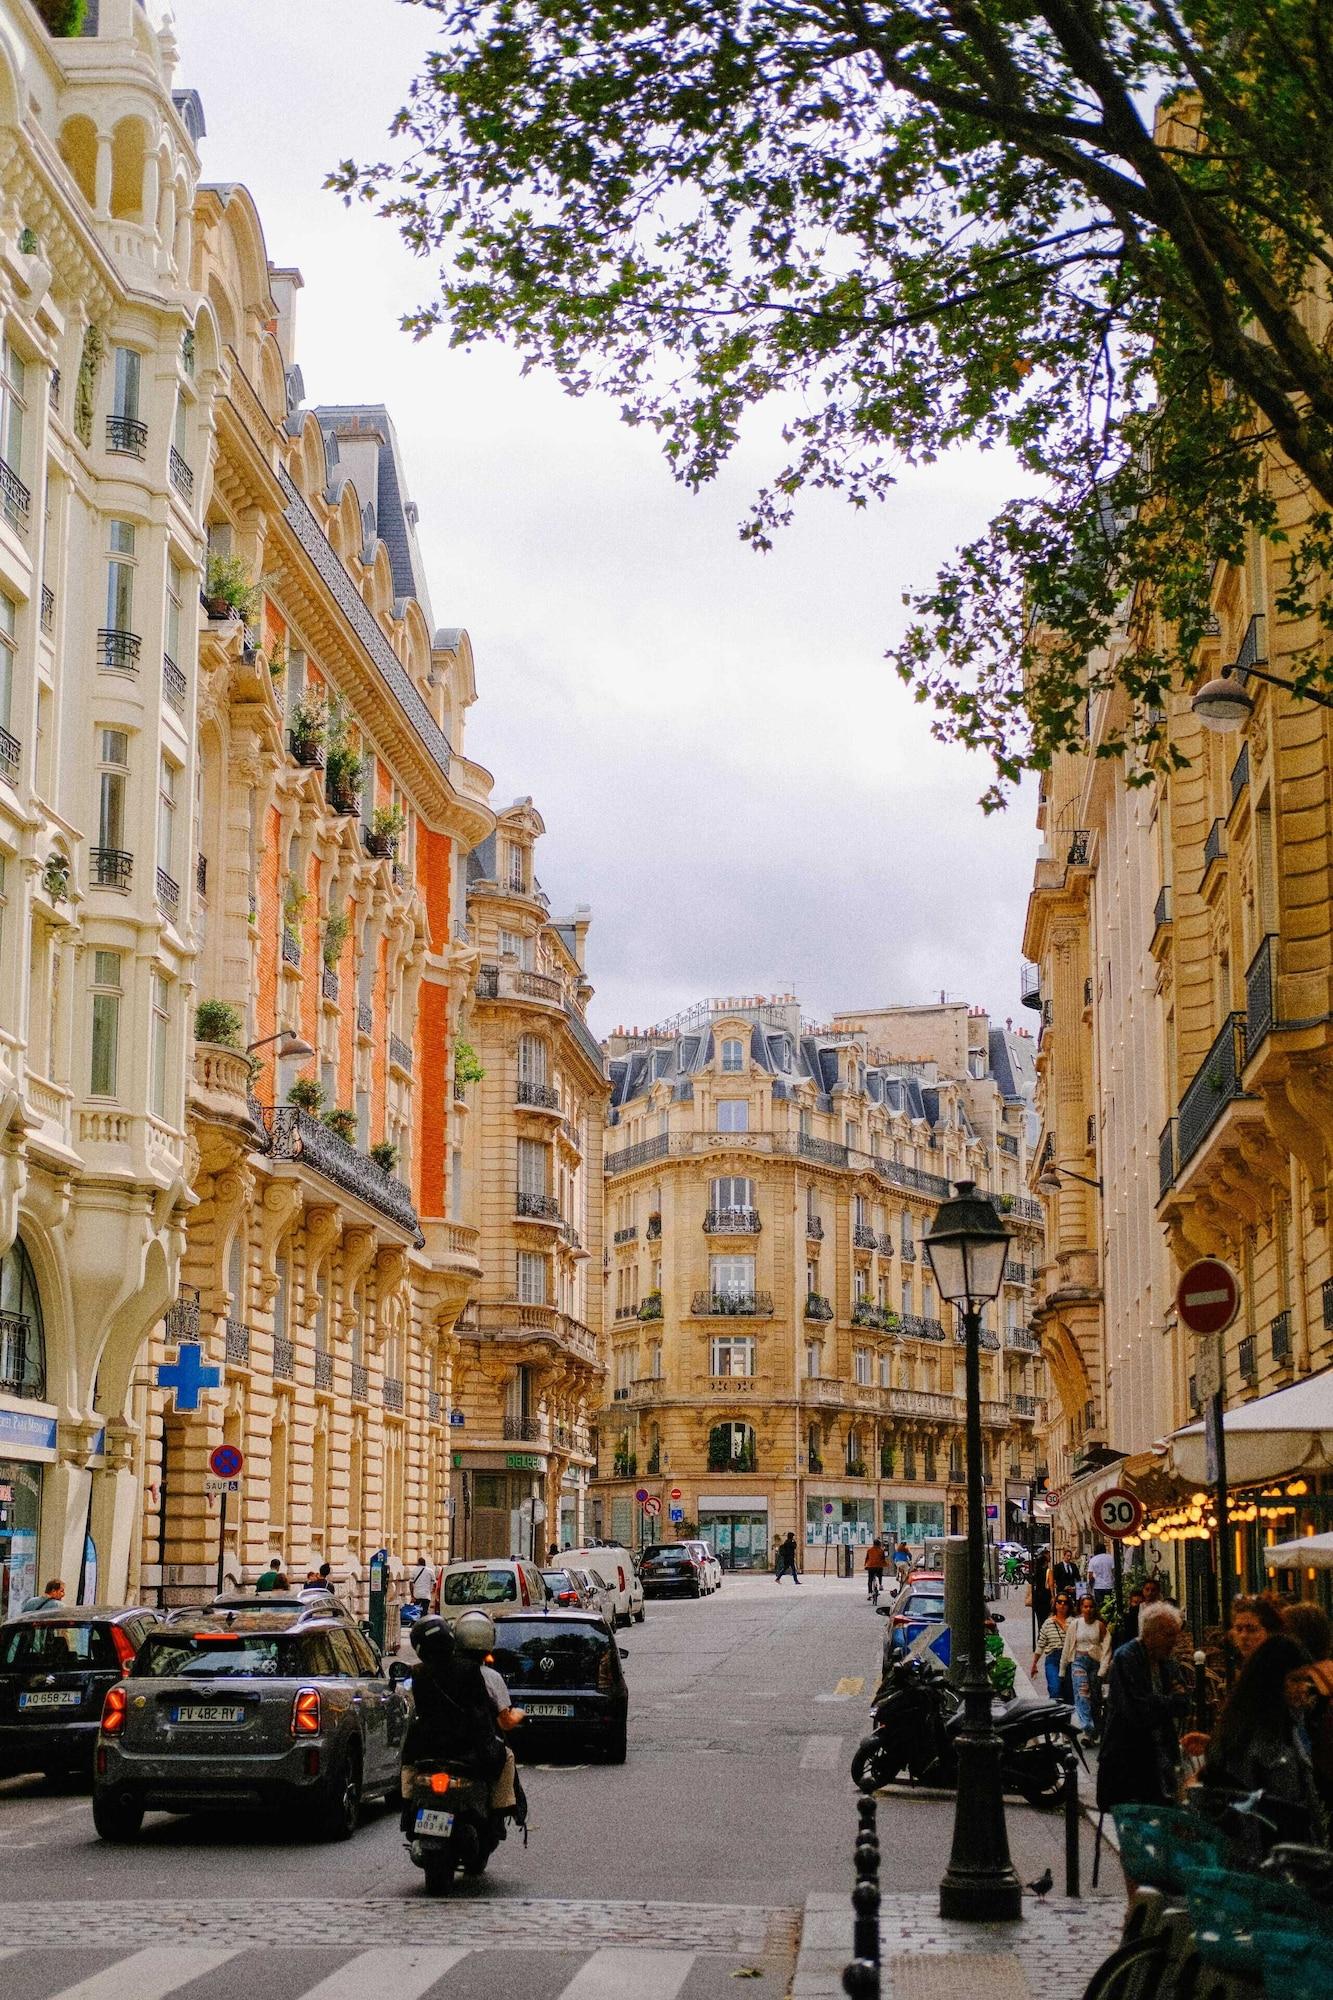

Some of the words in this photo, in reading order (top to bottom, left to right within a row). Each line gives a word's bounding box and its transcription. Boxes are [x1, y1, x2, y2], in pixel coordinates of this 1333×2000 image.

[206, 1482, 228, 1490] SAUF
[1048, 1495, 1058, 1503] 30
[1103, 1502, 1133, 1524] 30
